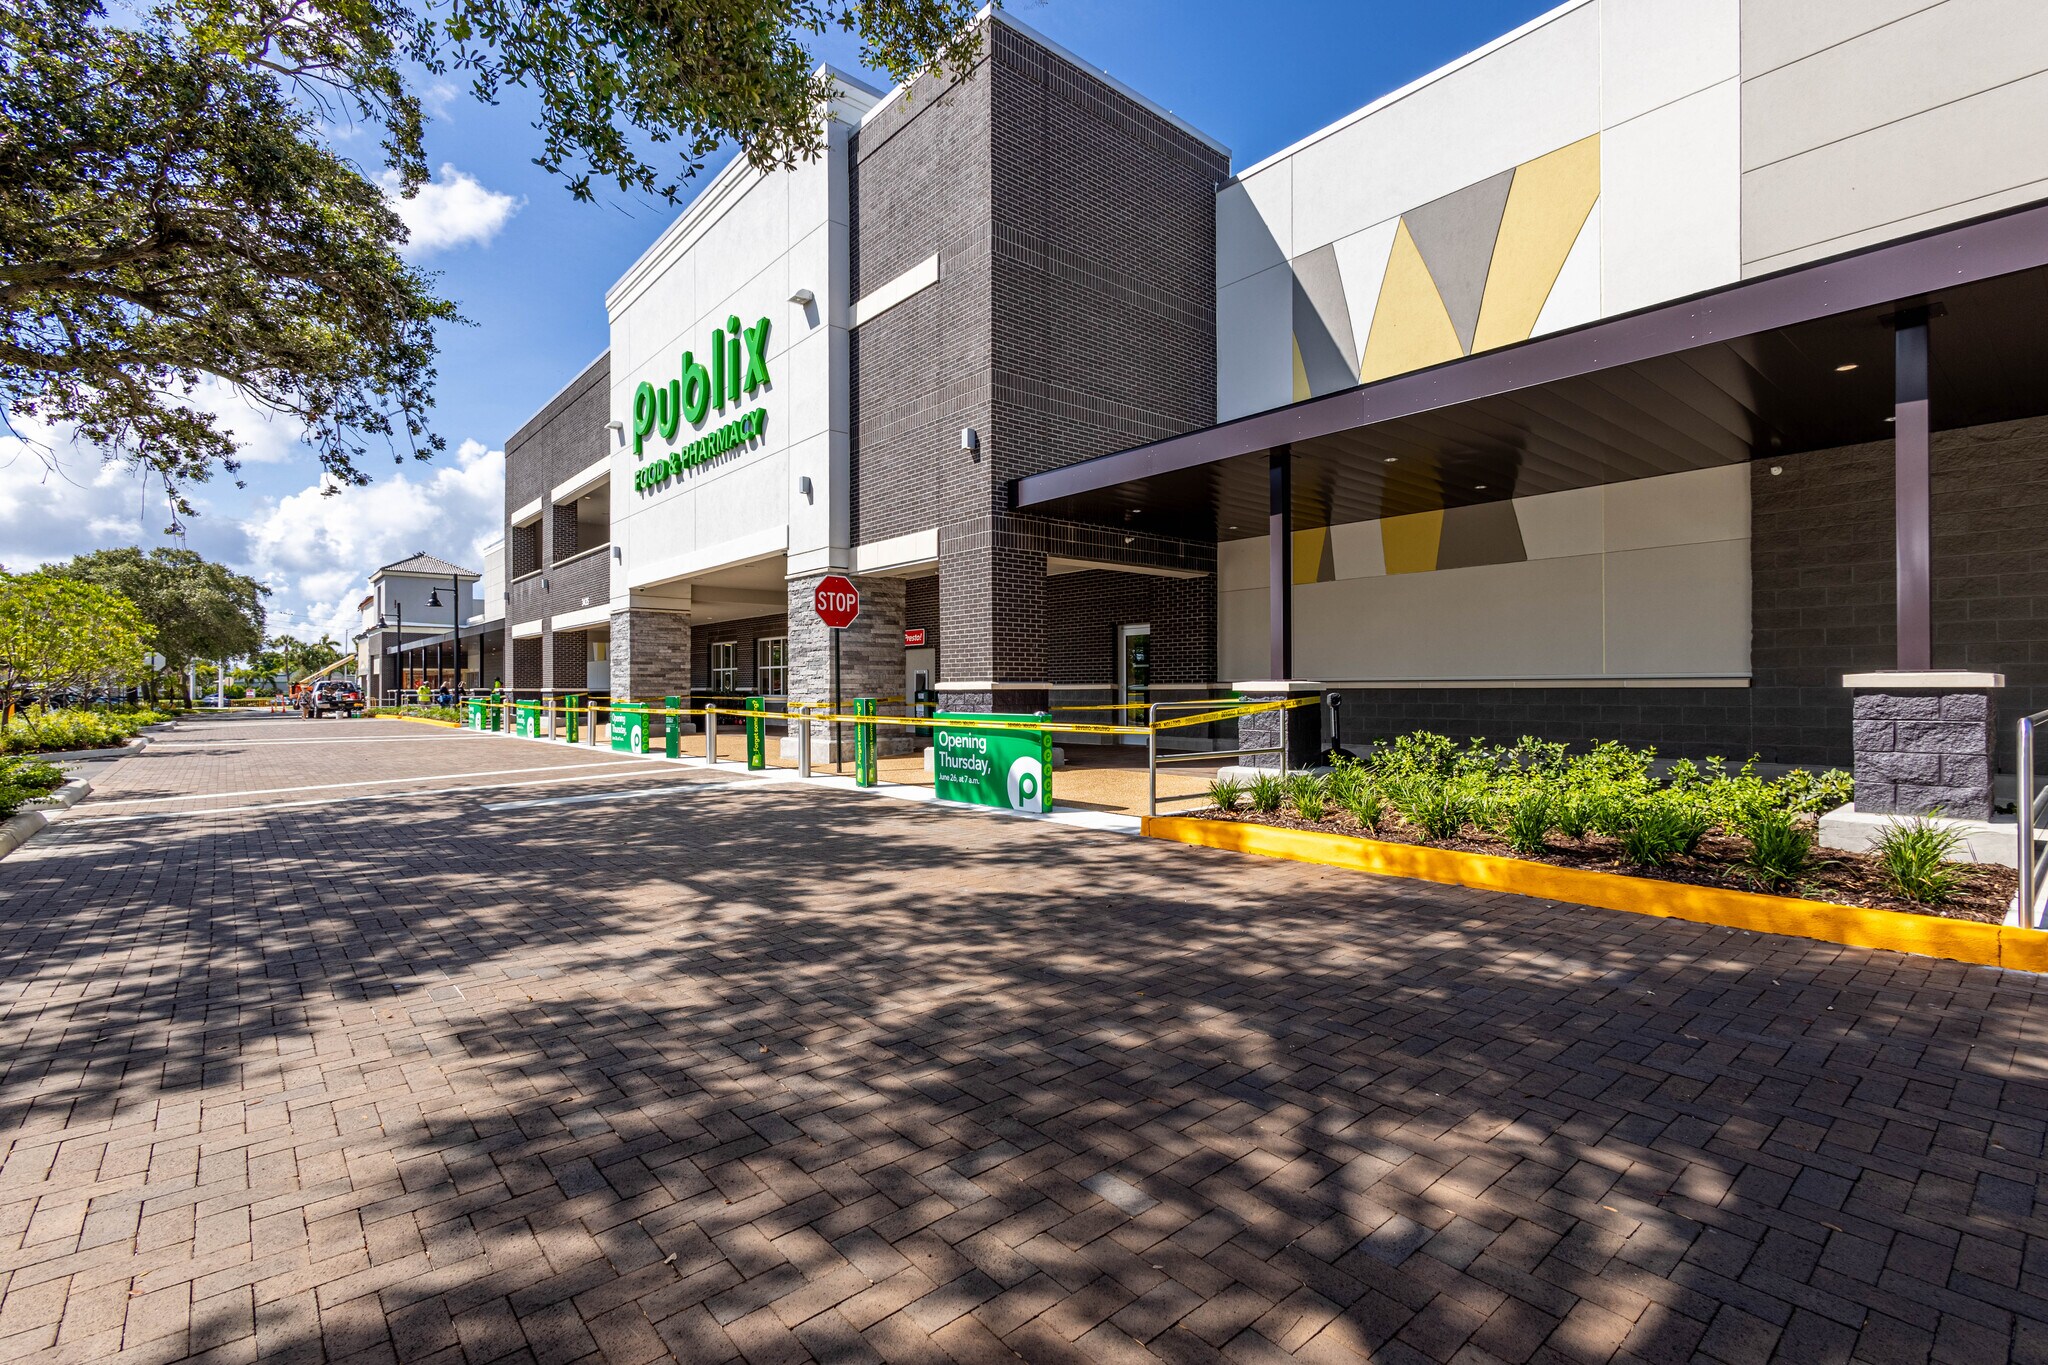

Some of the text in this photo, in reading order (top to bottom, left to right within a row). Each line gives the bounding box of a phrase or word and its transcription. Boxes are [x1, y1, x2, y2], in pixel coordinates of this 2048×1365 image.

[634, 407, 767, 492] FOOD & PHARMACY
[817, 591, 856, 612] STOP
[938, 731, 986, 754] Opening
[938, 751, 992, 776] Thursday,
[938, 772, 950, 781] June
[949, 773, 958, 782] 26,
